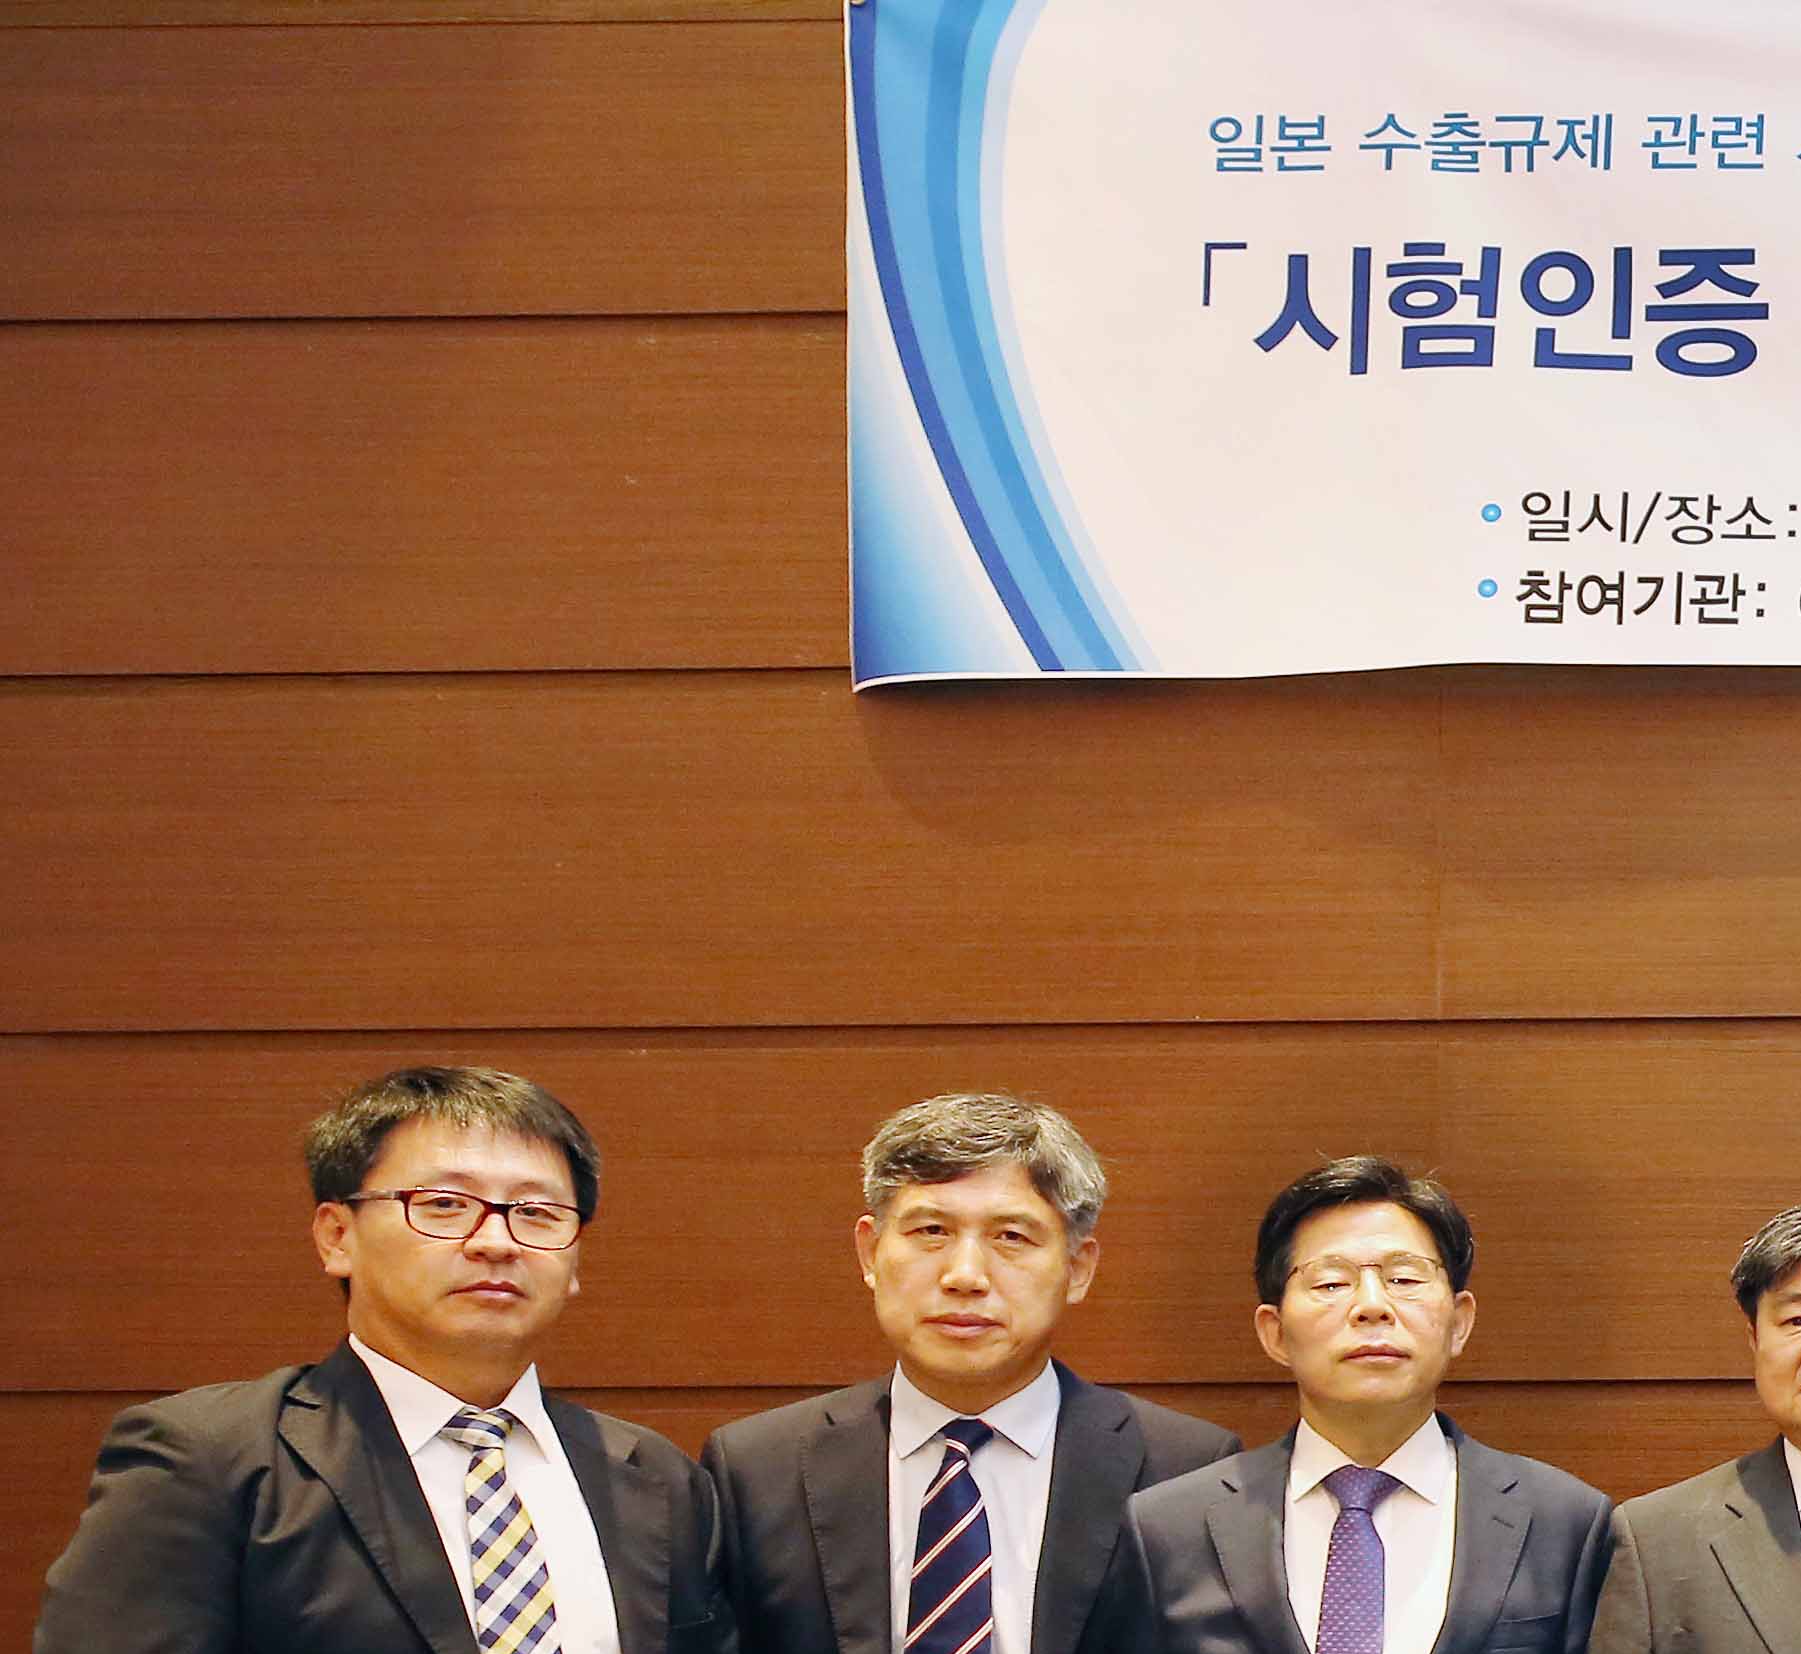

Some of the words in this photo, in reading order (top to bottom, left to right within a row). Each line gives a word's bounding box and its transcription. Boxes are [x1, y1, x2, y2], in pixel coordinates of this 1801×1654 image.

[1210, 115, 1331, 172] 일본
[1359, 113, 1612, 173] 수출규제
[1641, 113, 1764, 169] 관련
[1522, 490, 1797, 545] 일시/장소:
[1516, 570, 1766, 625] 참여기관:
